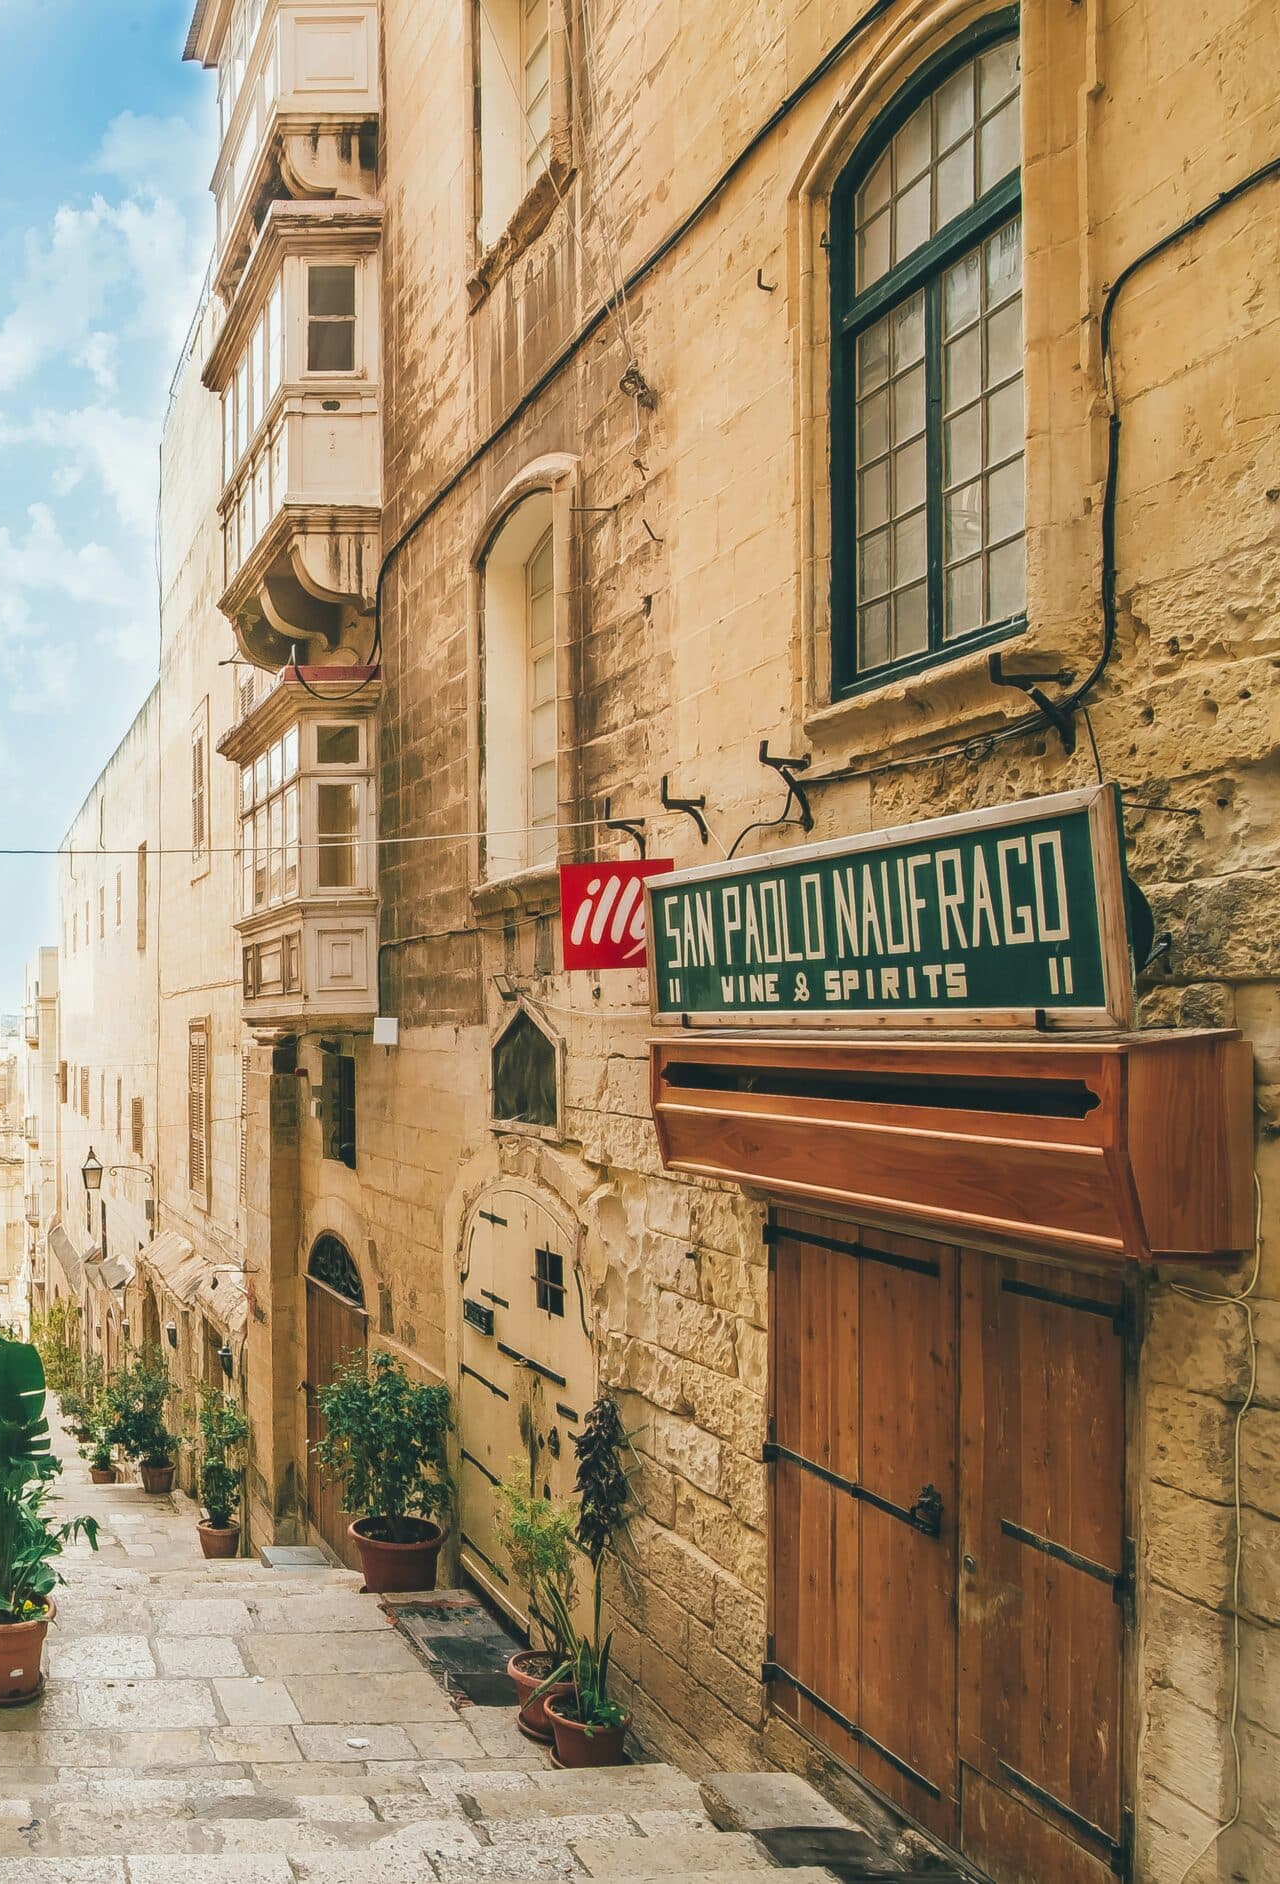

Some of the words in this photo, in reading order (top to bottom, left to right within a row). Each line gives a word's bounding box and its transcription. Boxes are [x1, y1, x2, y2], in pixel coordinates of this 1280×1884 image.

[664, 891, 715, 968] SAN
[722, 873, 825, 965] PAOLO
[832, 830, 1070, 958] NAUFRAGO
[721, 974, 780, 1003] WINE
[793, 972, 810, 1001] &
[824, 963, 968, 1001] SPIRITS
